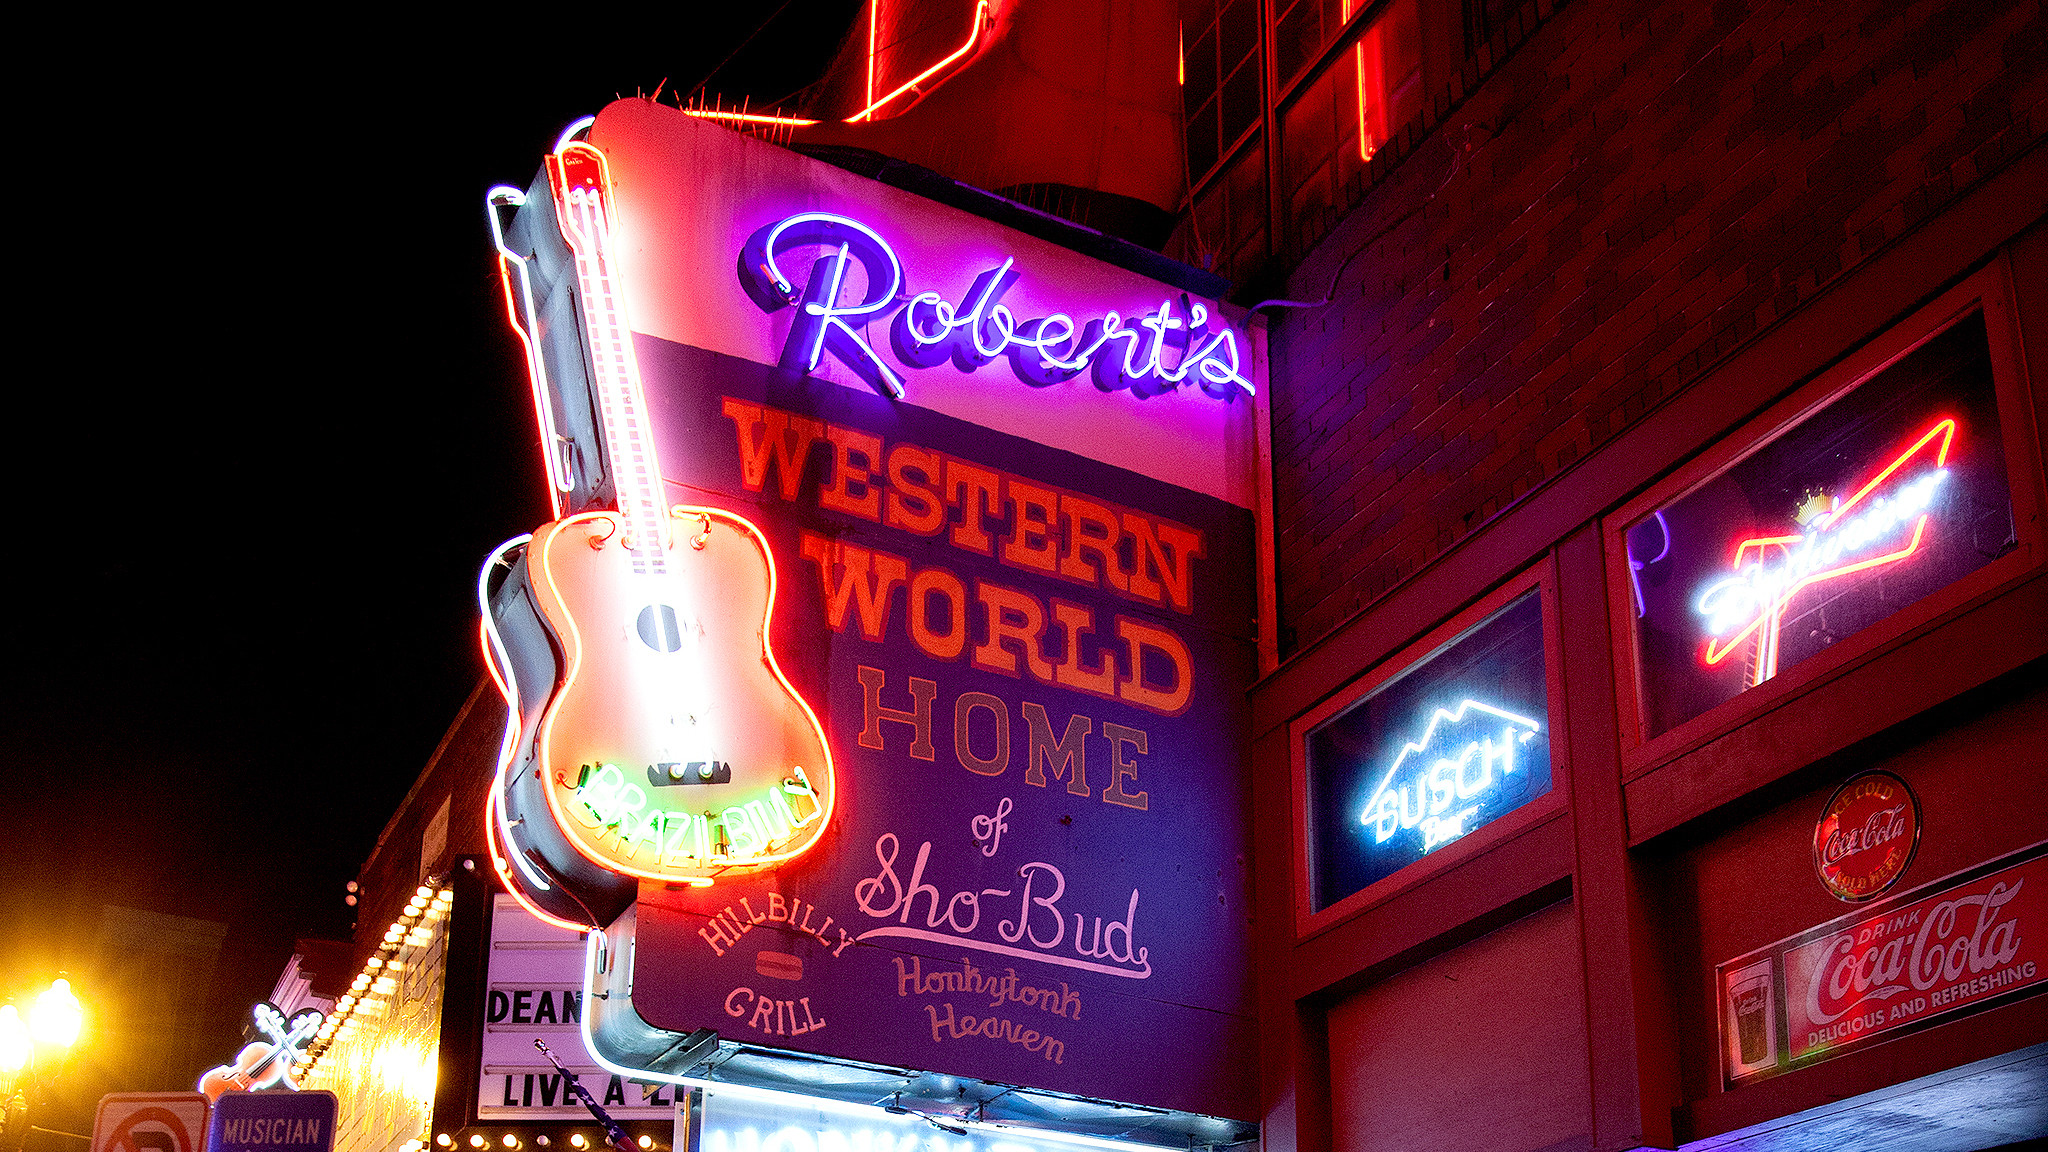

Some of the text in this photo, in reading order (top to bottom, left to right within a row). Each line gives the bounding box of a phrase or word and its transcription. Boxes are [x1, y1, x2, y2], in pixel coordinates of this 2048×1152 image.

[764, 212, 1255, 400] Robert's
[722, 396, 1206, 614] WESTERN
[801, 529, 1195, 718] WORLD
[858, 665, 1148, 810] HOME
[1375, 726, 1517, 845] BUSCH
[971, 797, 1013, 857] of
[1823, 804, 1907, 866] Coca-Cola
[698, 892, 855, 957] HILLBILLY
[855, 833, 1151, 970] Sho-Bud
[1857, 906, 1922, 946] DRINK
[1805, 877, 2025, 1026] Coca-Cola
[486, 990, 582, 1024] DEAN
[724, 987, 827, 1036] GRILL
[892, 956, 1081, 1020] Honkytonk
[1808, 961, 2037, 1048] DELICIOUS AND REFRESHING
[924, 1003, 1065, 1065] Heaven
[503, 1074, 579, 1106] LIVE
[222, 1118, 320, 1144] MUSICIAN
